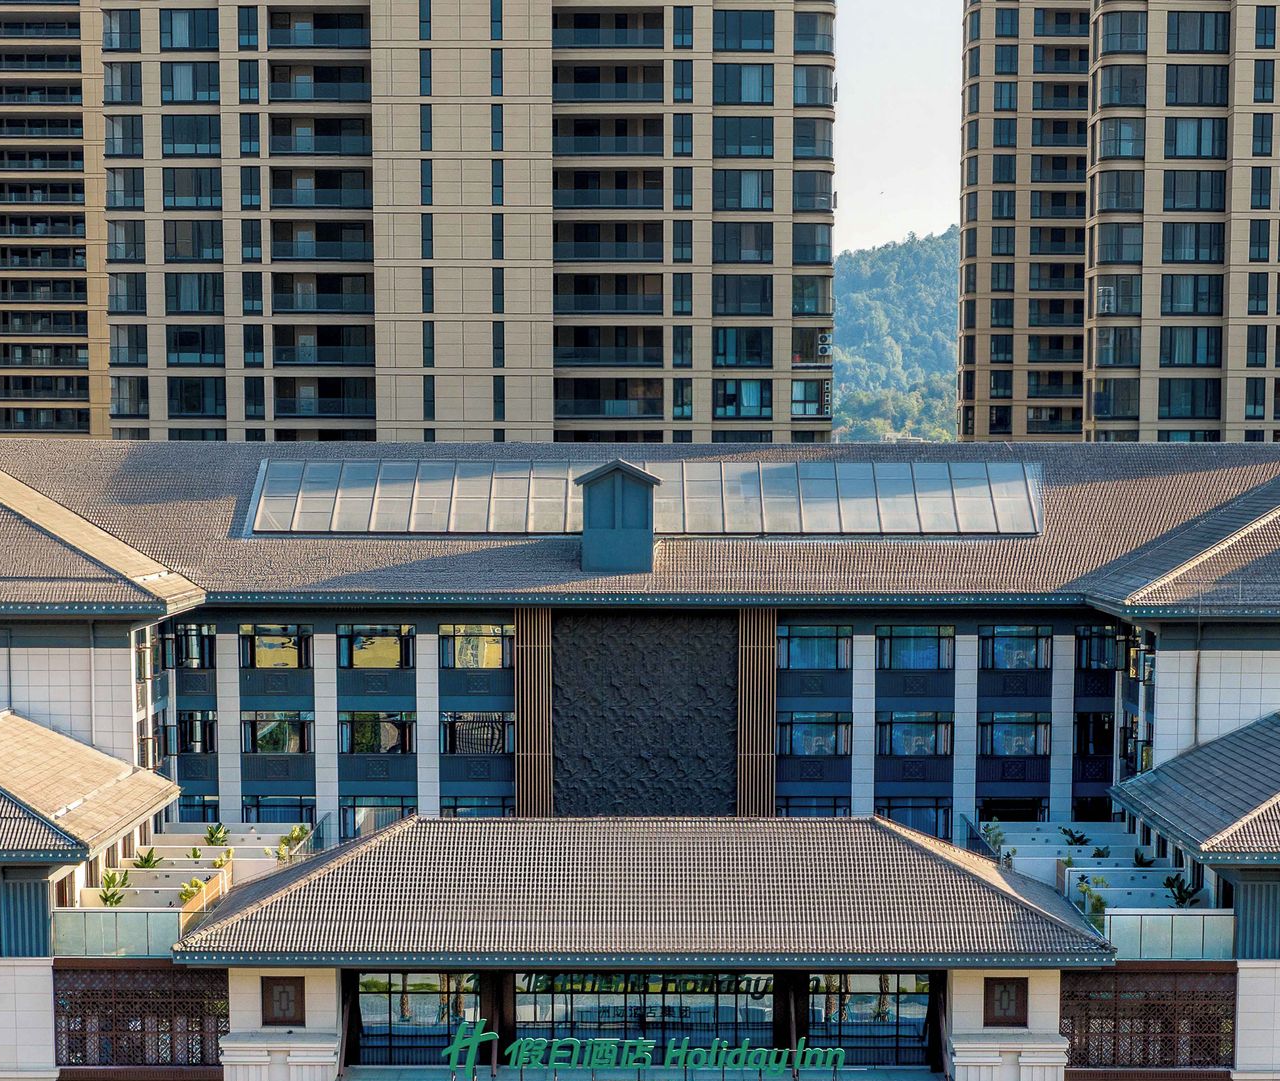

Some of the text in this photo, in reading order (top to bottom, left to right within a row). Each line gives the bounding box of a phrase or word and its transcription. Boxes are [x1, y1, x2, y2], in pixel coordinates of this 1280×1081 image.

[504, 1036, 846, 1077] 假日酒店 Holiday Inn
